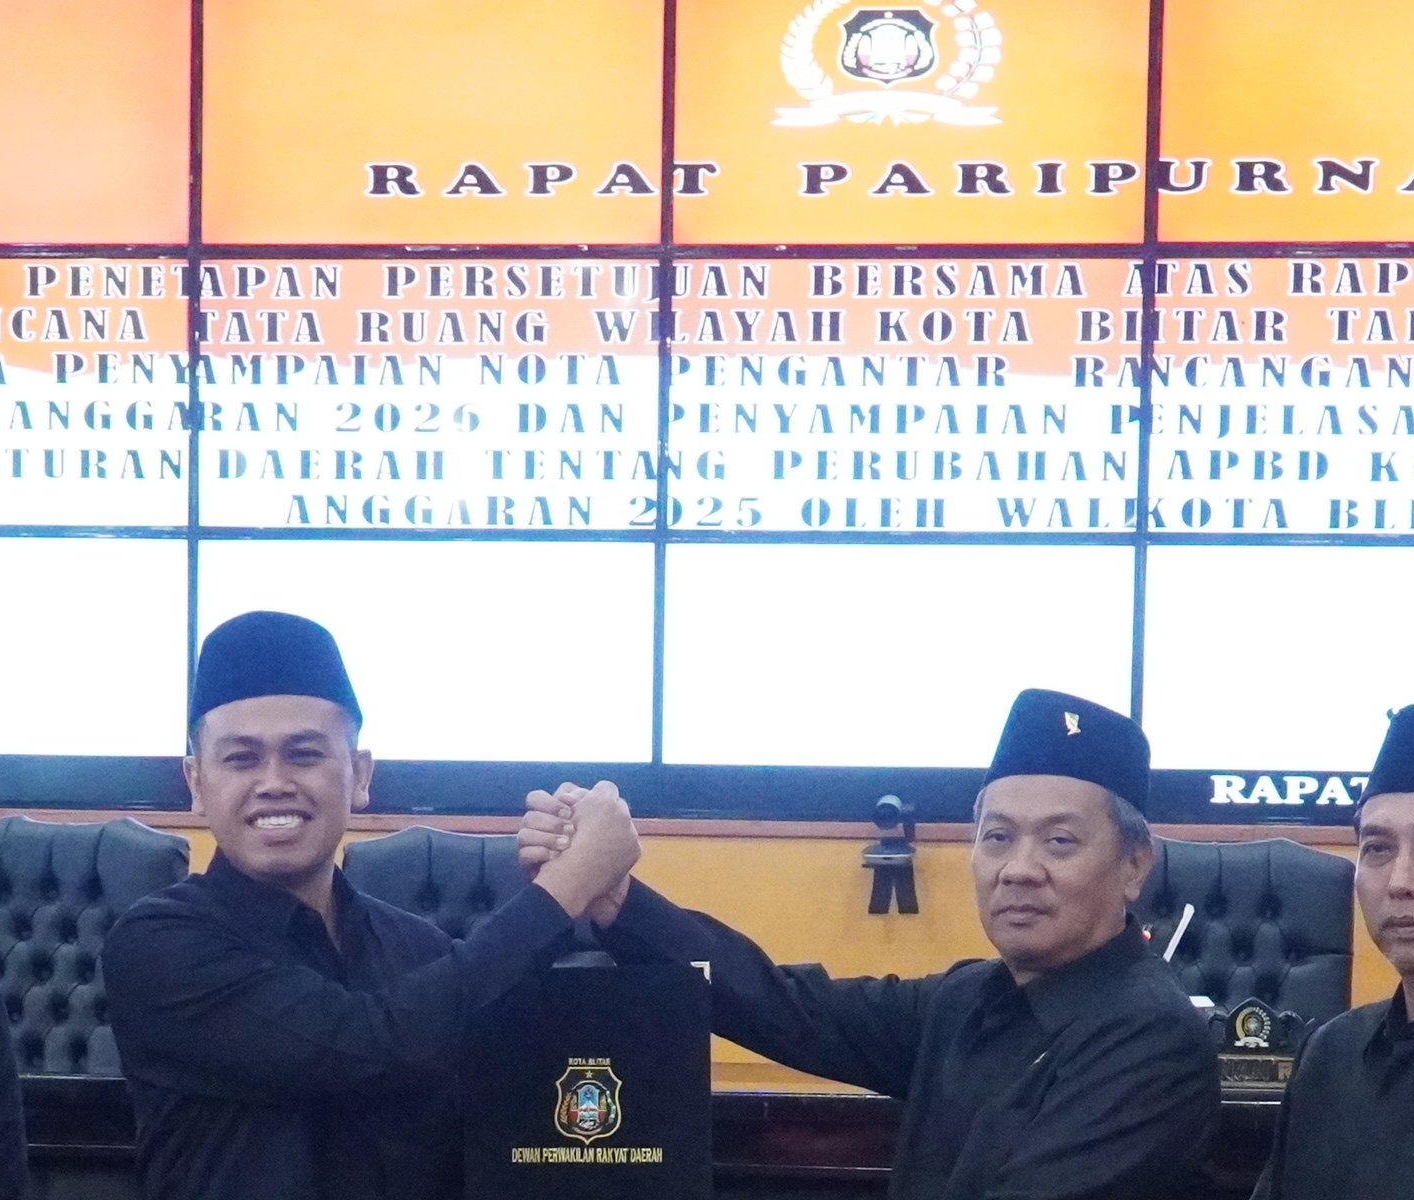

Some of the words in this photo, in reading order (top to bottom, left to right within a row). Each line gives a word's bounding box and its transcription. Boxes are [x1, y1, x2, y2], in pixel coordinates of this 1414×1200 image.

[367, 161, 718, 197] RAPAT
[25, 265, 340, 298] PENETAPAN
[387, 265, 767, 302] PERSETUJUAN
[812, 263, 1085, 297] BERSAMA
[1125, 262, 1251, 295] ATAS
[199, 310, 322, 342] TATA
[359, 311, 547, 343] RUANG
[878, 310, 1031, 342] KOTA
[54, 353, 443, 386] PENYAMPAIAN
[478, 354, 621, 386] NOTA
[668, 355, 1007, 388] PENGANTAR
[1074, 356, 1414, 388] RANCANGAN
[8, 400, 299, 432] ANGGARAN
[335, 401, 480, 433] 2026
[516, 402, 624, 433] DAN
[668, 402, 1067, 434] PENYAMPAIAN
[217, 449, 446, 481] DAERAH
[485, 449, 726, 481] TENTANG
[772, 450, 1127, 481] PERUBAHAN
[1166, 449, 1329, 482] APBD
[285, 494, 592, 526] ANGGARAN
[628, 495, 762, 528] 2025
[800, 496, 945, 528] OLEH
[511, 1148, 541, 1164] DEWAN
[542, 1148, 595, 1164] PERWAKILAN
[596, 1148, 628, 1164] RAKYAT
[629, 1148, 663, 1164] DAERAH
